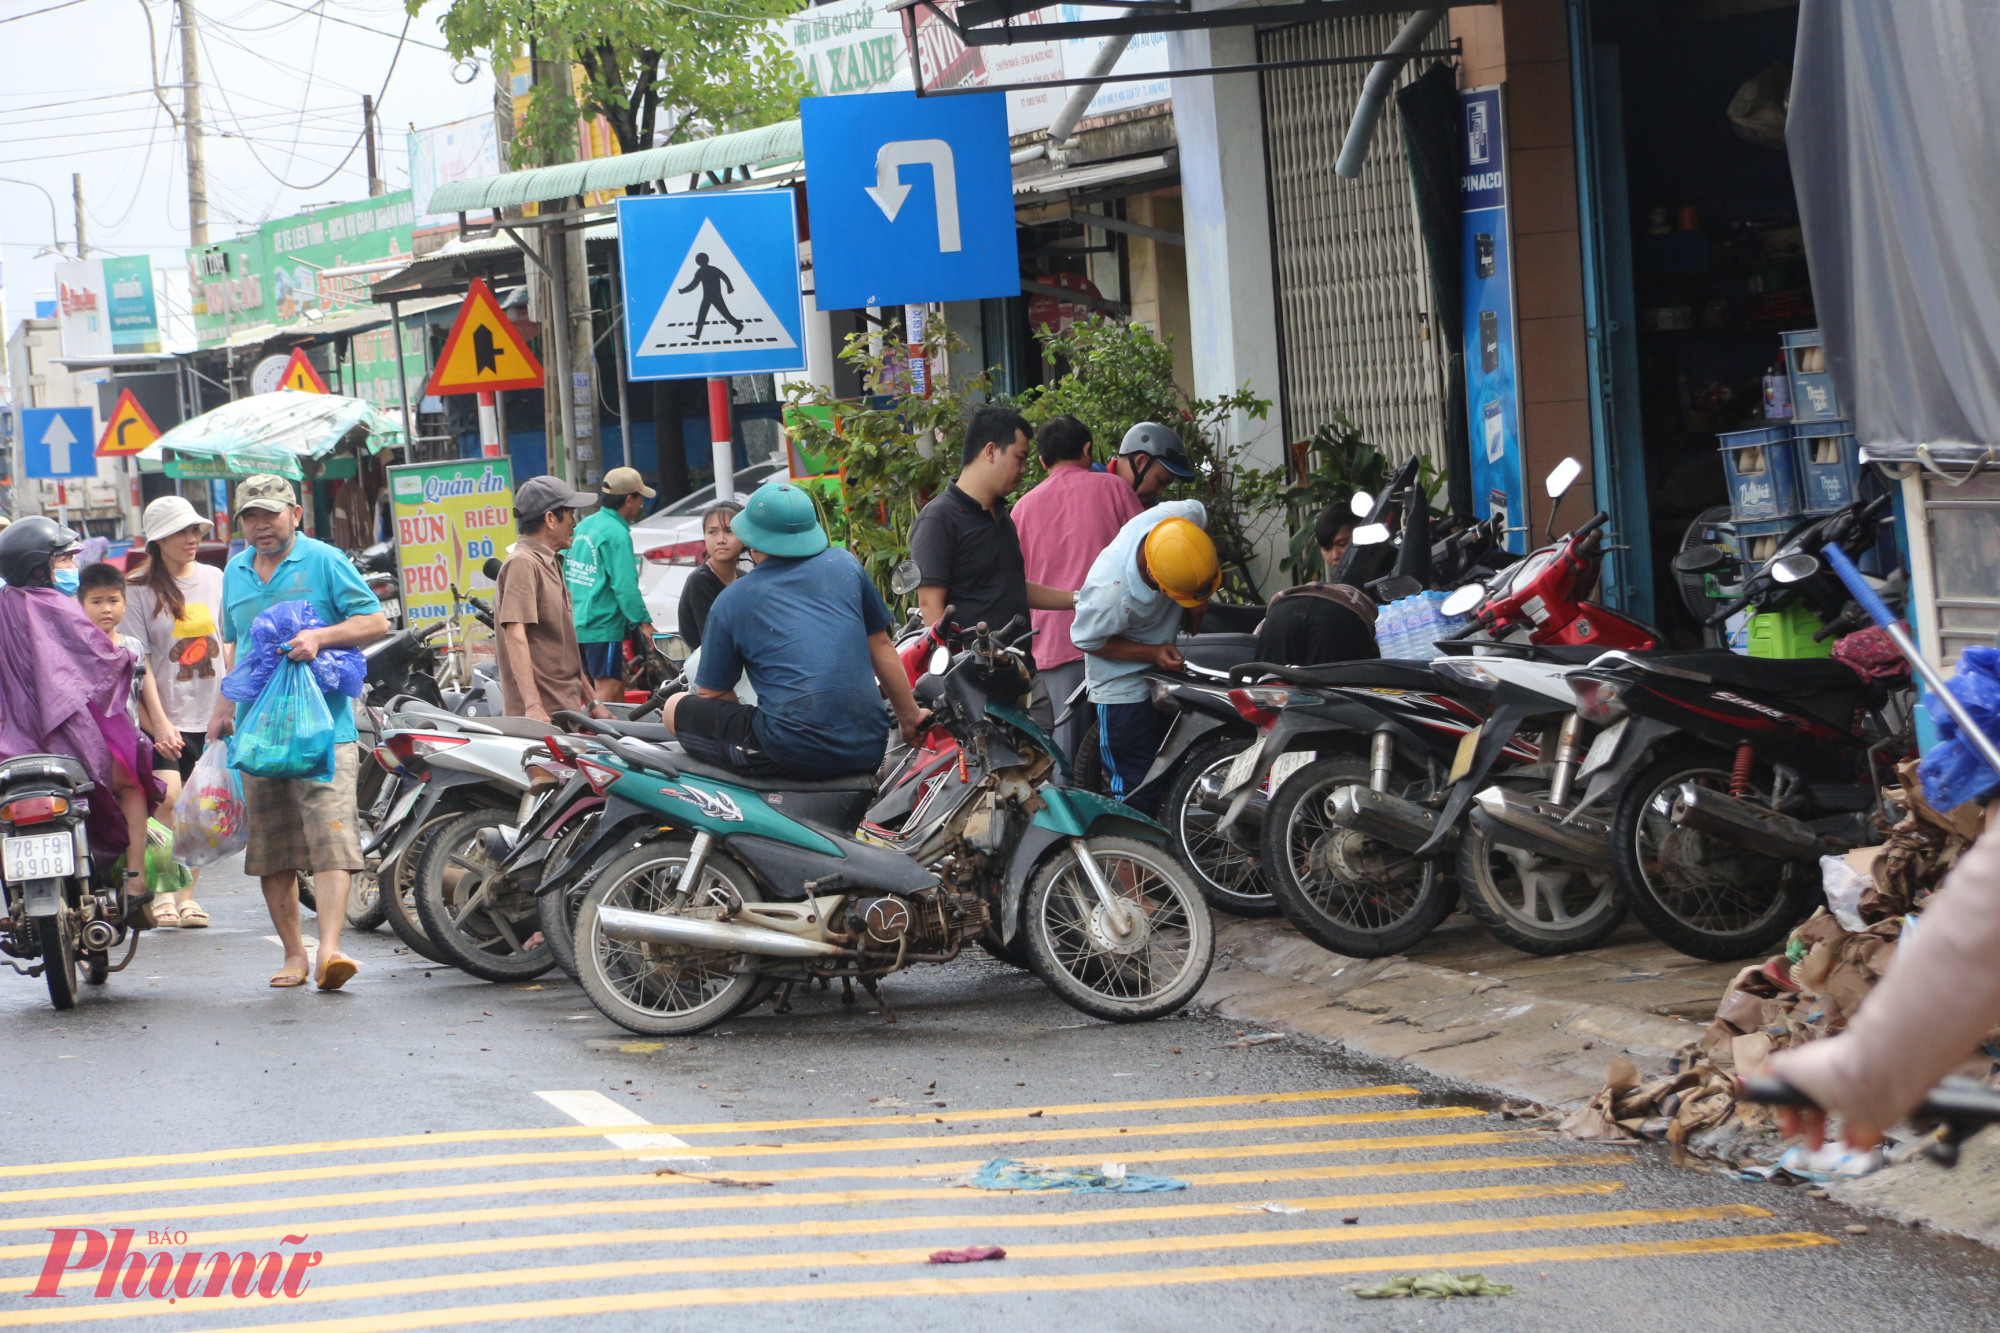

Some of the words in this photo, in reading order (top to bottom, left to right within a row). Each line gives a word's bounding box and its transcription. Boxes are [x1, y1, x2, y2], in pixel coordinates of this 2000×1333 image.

[832, 11, 852, 36] CAO
[826, 34, 896, 94] XANH
[1461, 171, 1502, 192] PINACO
[477, 465, 504, 494] Ăn
[398, 509, 446, 546] BÚN
[464, 505, 509, 529] RIÊU
[404, 553, 449, 594] PHỞ
[467, 535, 494, 560] BÒ
[408, 602, 447, 620] BÚN
[14, 837, 61, 858] 78-F9
[15, 857, 63, 877] 8908
